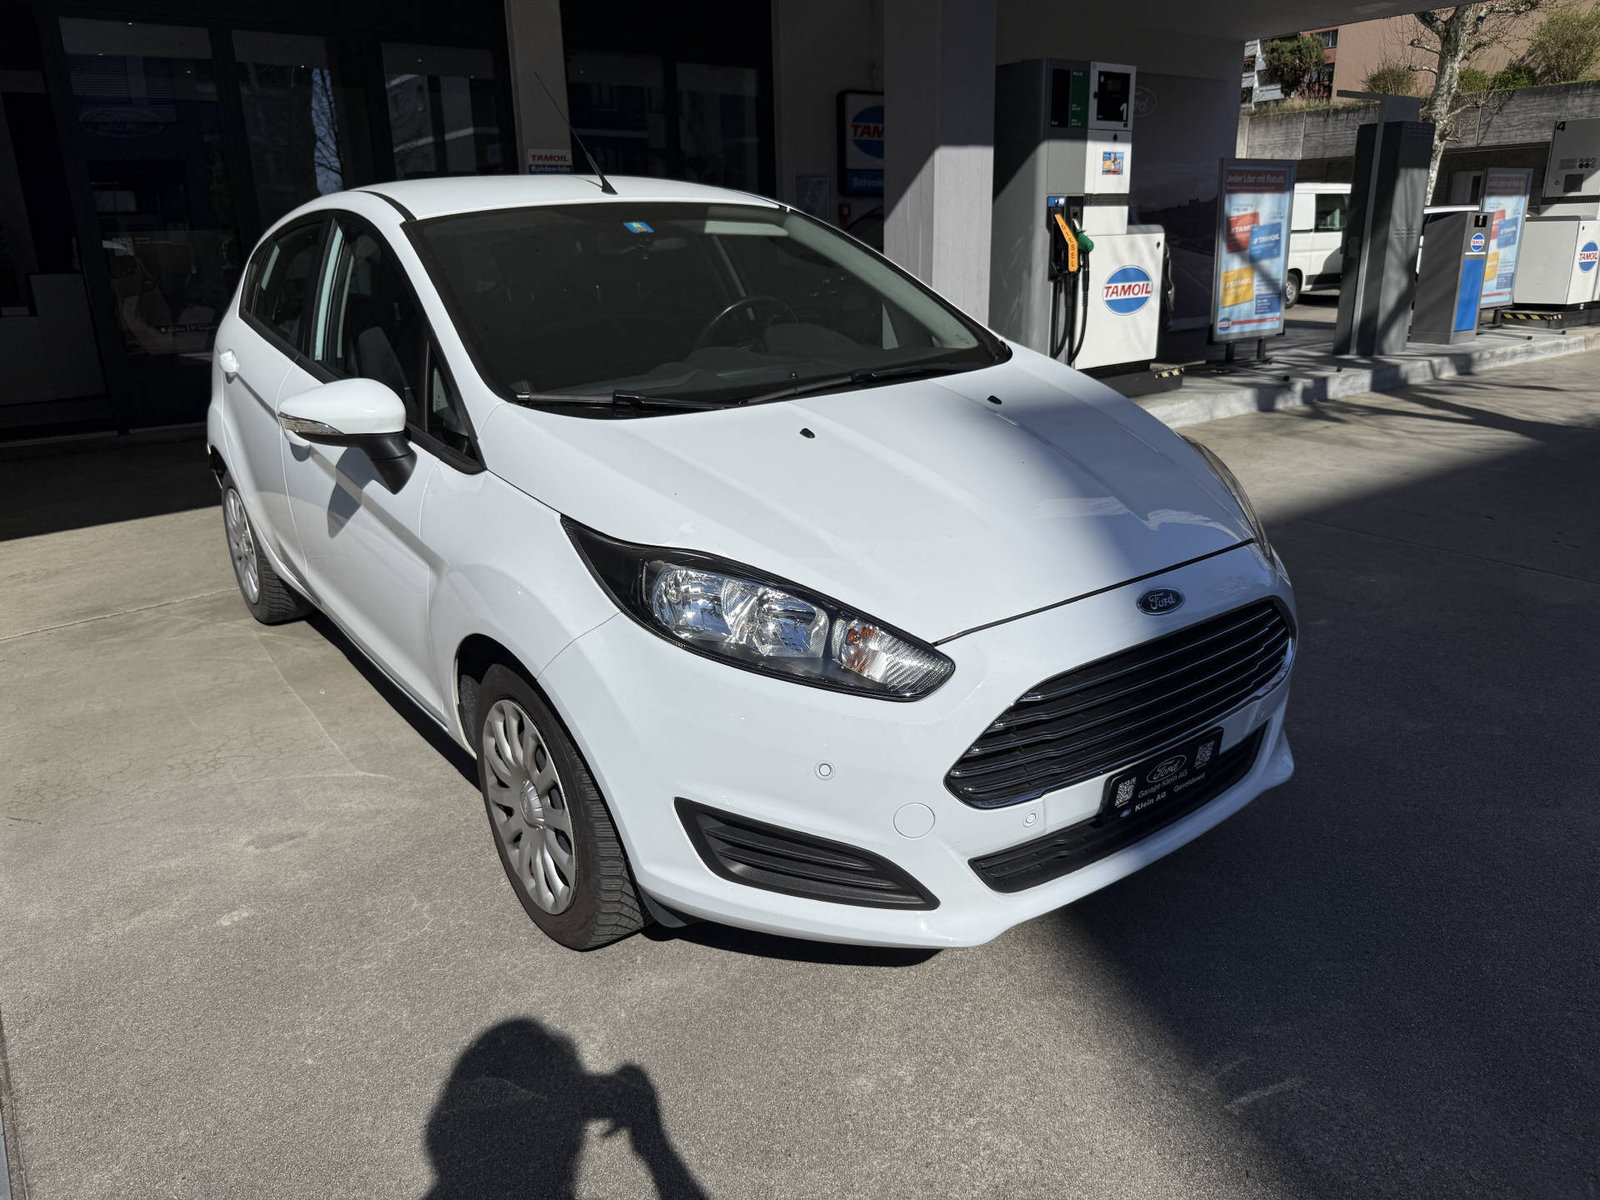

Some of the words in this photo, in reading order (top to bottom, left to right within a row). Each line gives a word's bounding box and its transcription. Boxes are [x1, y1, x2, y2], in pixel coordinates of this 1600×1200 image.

[1120, 103, 1128, 120] 1
[1556, 121, 1566, 132] 4
[531, 154, 569, 162] TAMOIL
[1061, 224, 1076, 268] DIESEL
[1578, 252, 1598, 261] TAMOIL
[1104, 283, 1152, 298] TAMOIL
[1149, 592, 1175, 610] Ford
[1153, 759, 1180, 780] Ford
[1138, 783, 1161, 798] Garage
[1162, 775, 1178, 786] Klein
[1178, 769, 1188, 779] AG
[1134, 798, 1154, 812] Klein
[1156, 791, 1167, 802] AG
